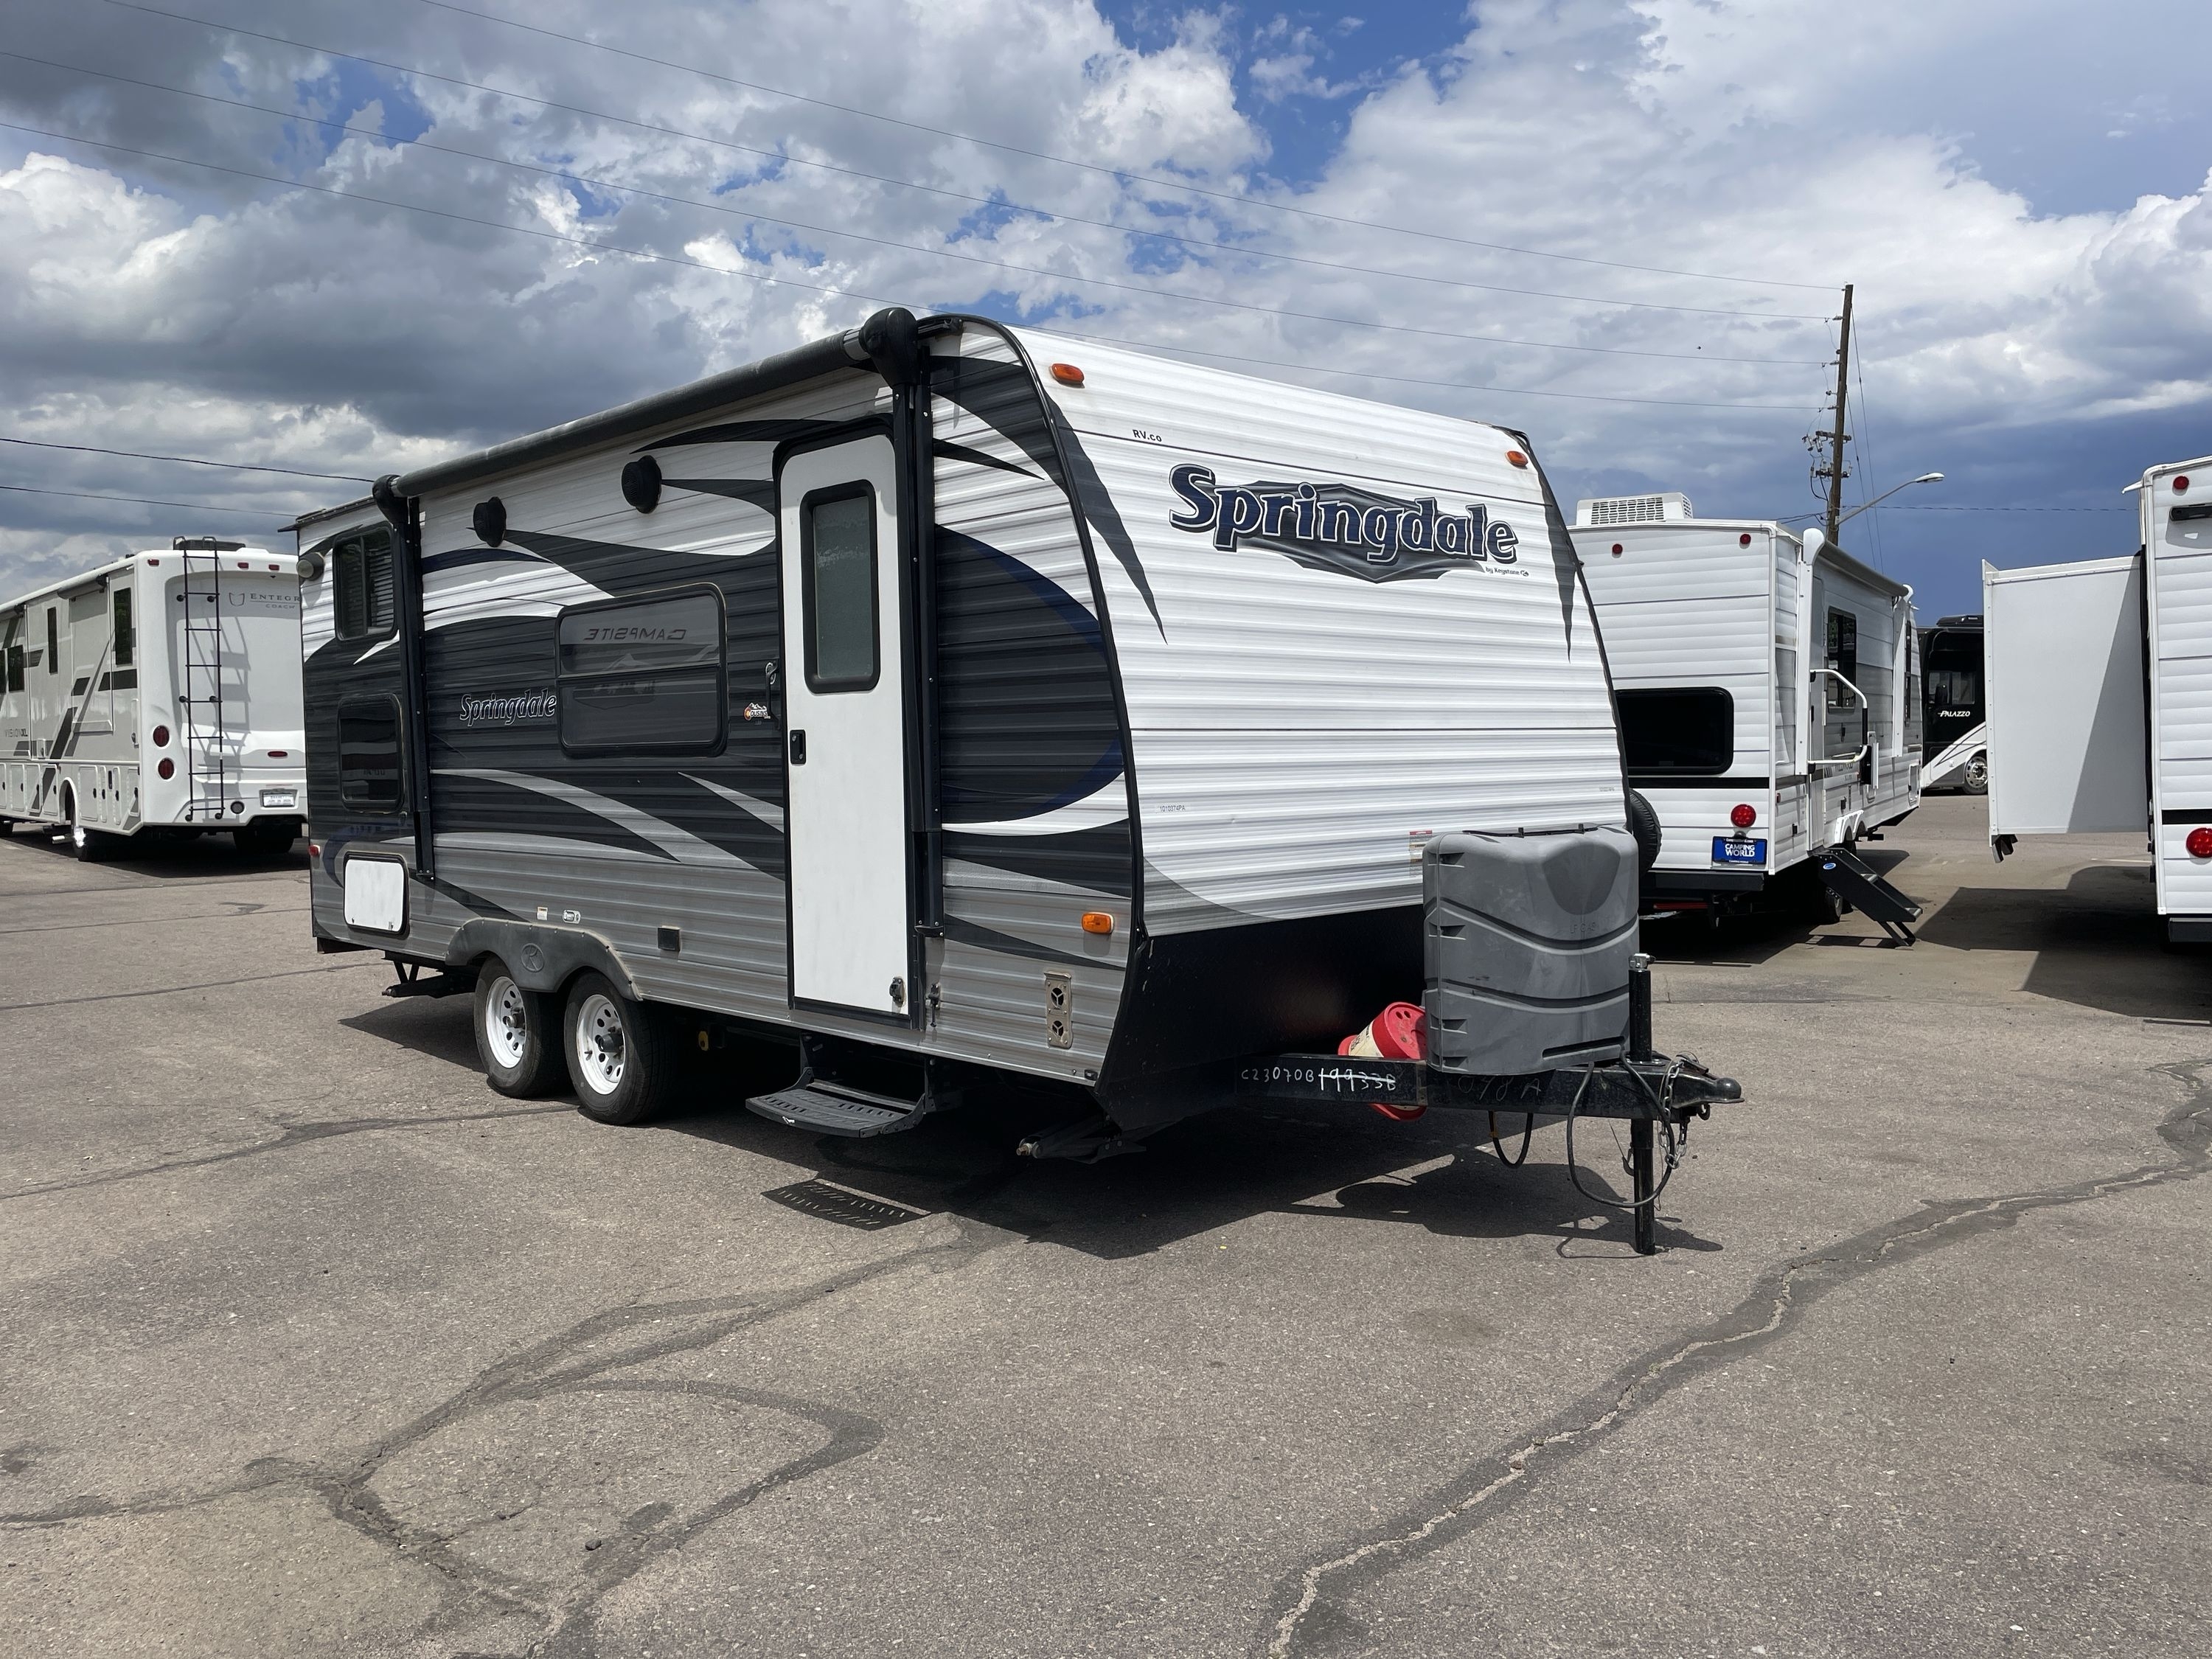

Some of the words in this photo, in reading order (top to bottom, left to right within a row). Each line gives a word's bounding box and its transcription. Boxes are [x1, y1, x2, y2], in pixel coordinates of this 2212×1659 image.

[1133, 429, 1162, 442] RV.co
[1169, 464, 1519, 564] Springdale
[1494, 567, 1520, 575] Keystone
[459, 688, 557, 727] Springdale
